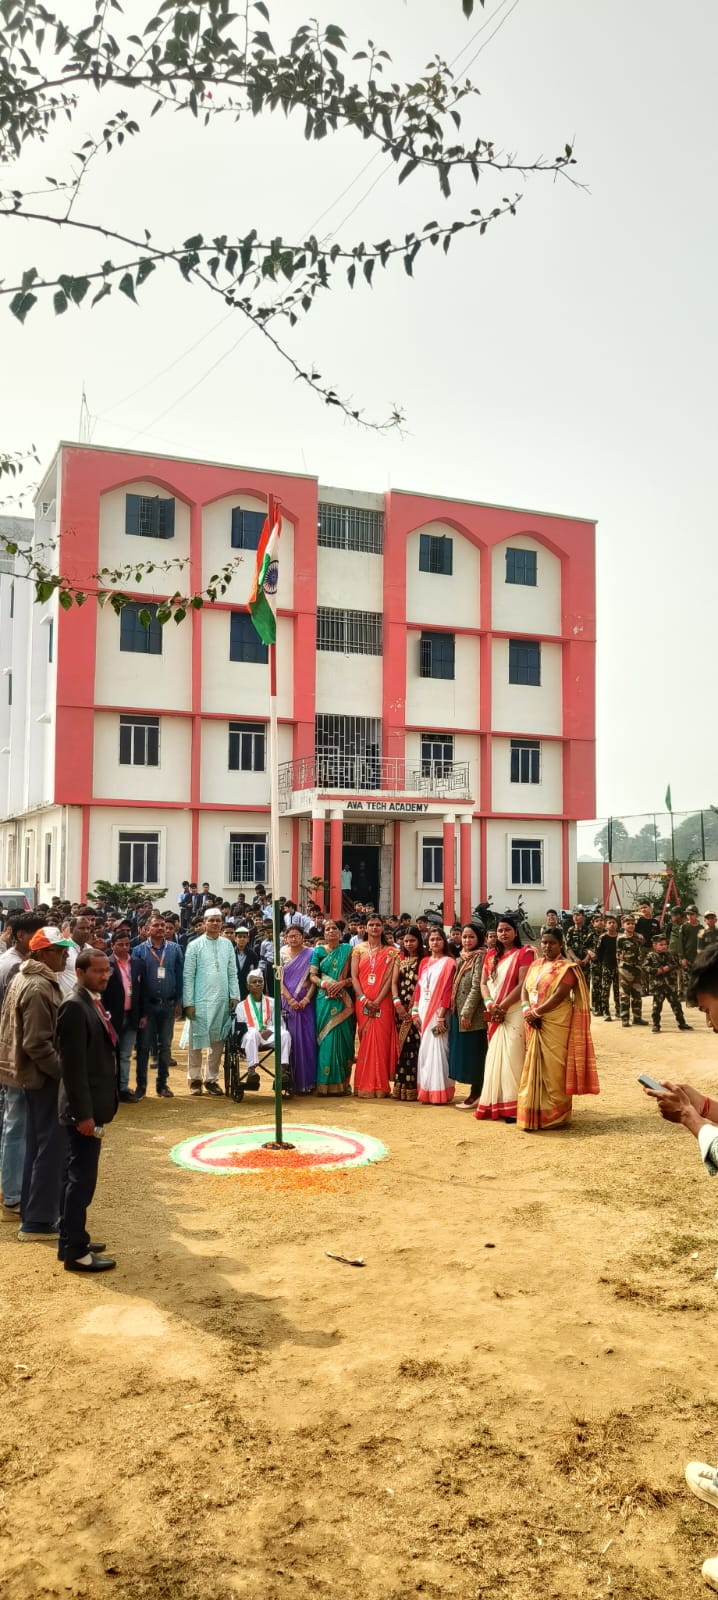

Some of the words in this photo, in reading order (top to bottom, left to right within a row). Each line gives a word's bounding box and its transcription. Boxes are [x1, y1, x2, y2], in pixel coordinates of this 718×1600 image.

[347, 801, 363, 810] AVA
[366, 802, 387, 810] TECH
[389, 803, 429, 812] ACADEMY
